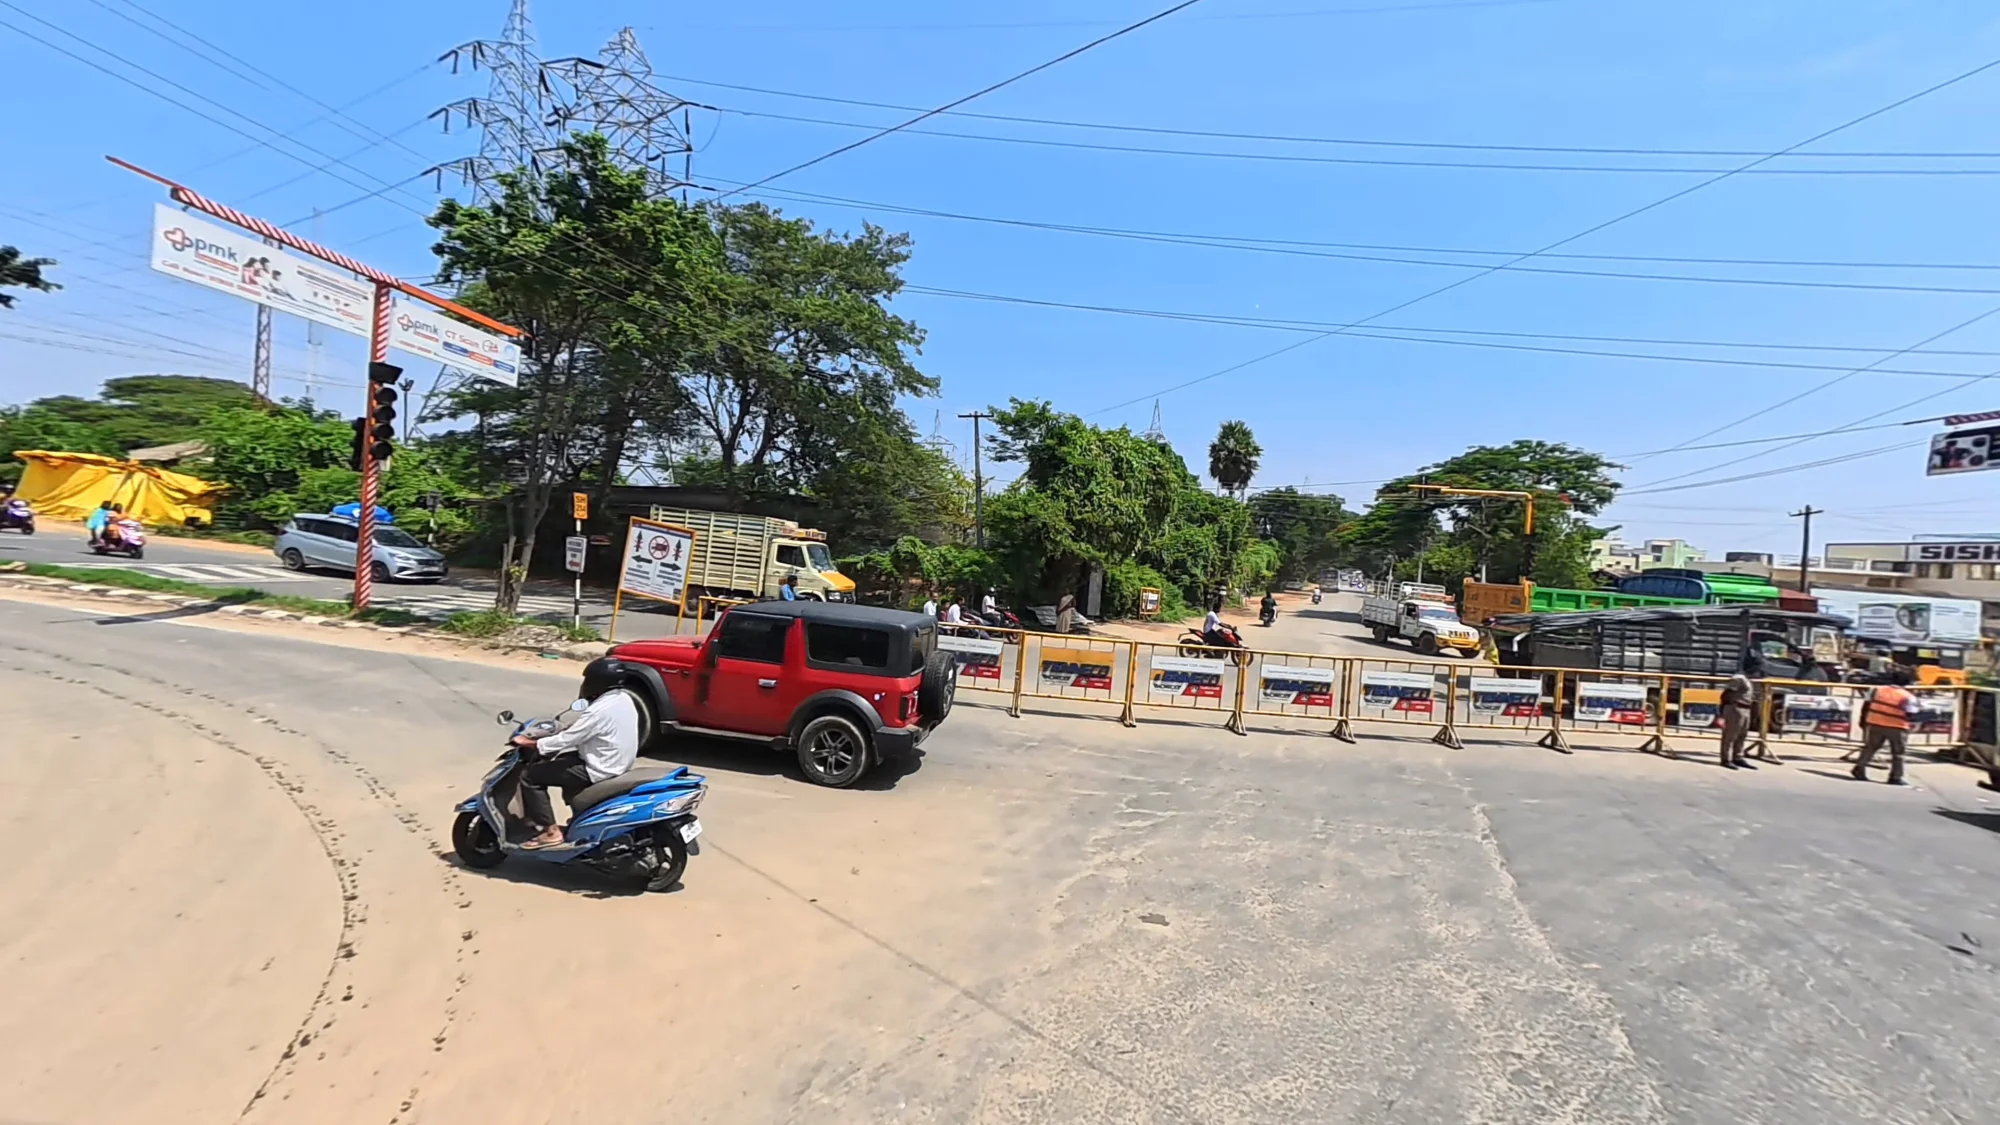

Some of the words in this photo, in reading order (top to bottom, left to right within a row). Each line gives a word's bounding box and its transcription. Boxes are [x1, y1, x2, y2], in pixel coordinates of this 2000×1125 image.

[194, 238, 238, 262] pmk
[413, 320, 439, 335] pmk
[445, 329, 457, 340] CT
[458, 335, 480, 348] Scan
